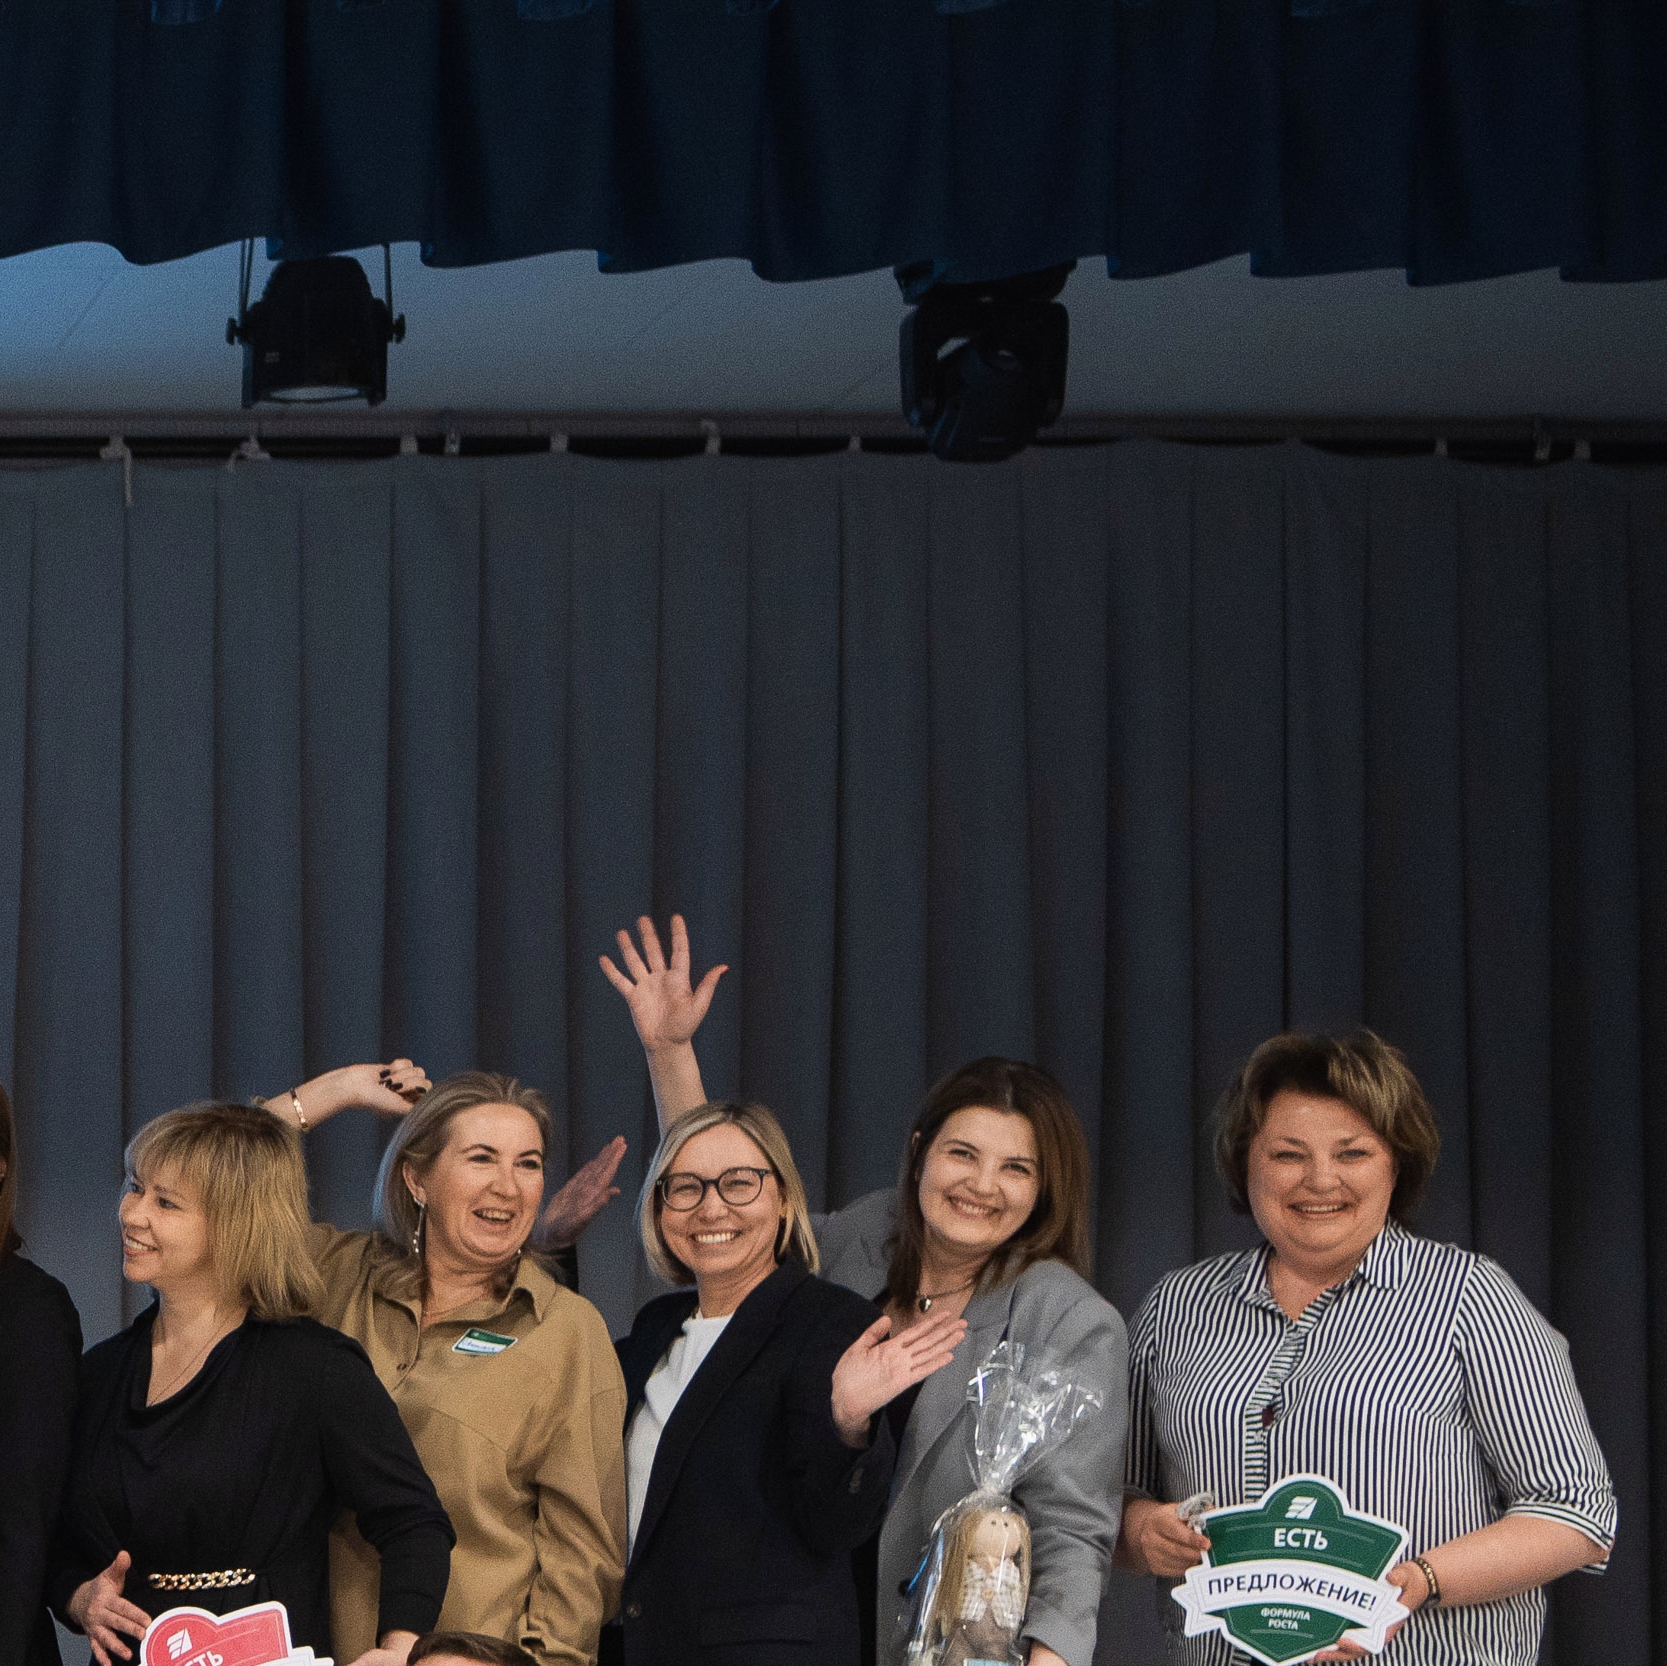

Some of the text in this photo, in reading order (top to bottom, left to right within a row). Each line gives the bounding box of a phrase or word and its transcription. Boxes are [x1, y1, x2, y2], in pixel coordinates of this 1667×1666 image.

[1273, 1528, 1329, 1550] ЕСТЬ
[1208, 1573, 1377, 1611] ПРЕДЛОЖЕНИЕ!
[1260, 1607, 1311, 1621] ФОРМУЛА
[1268, 1618, 1299, 1631] РОСТА
